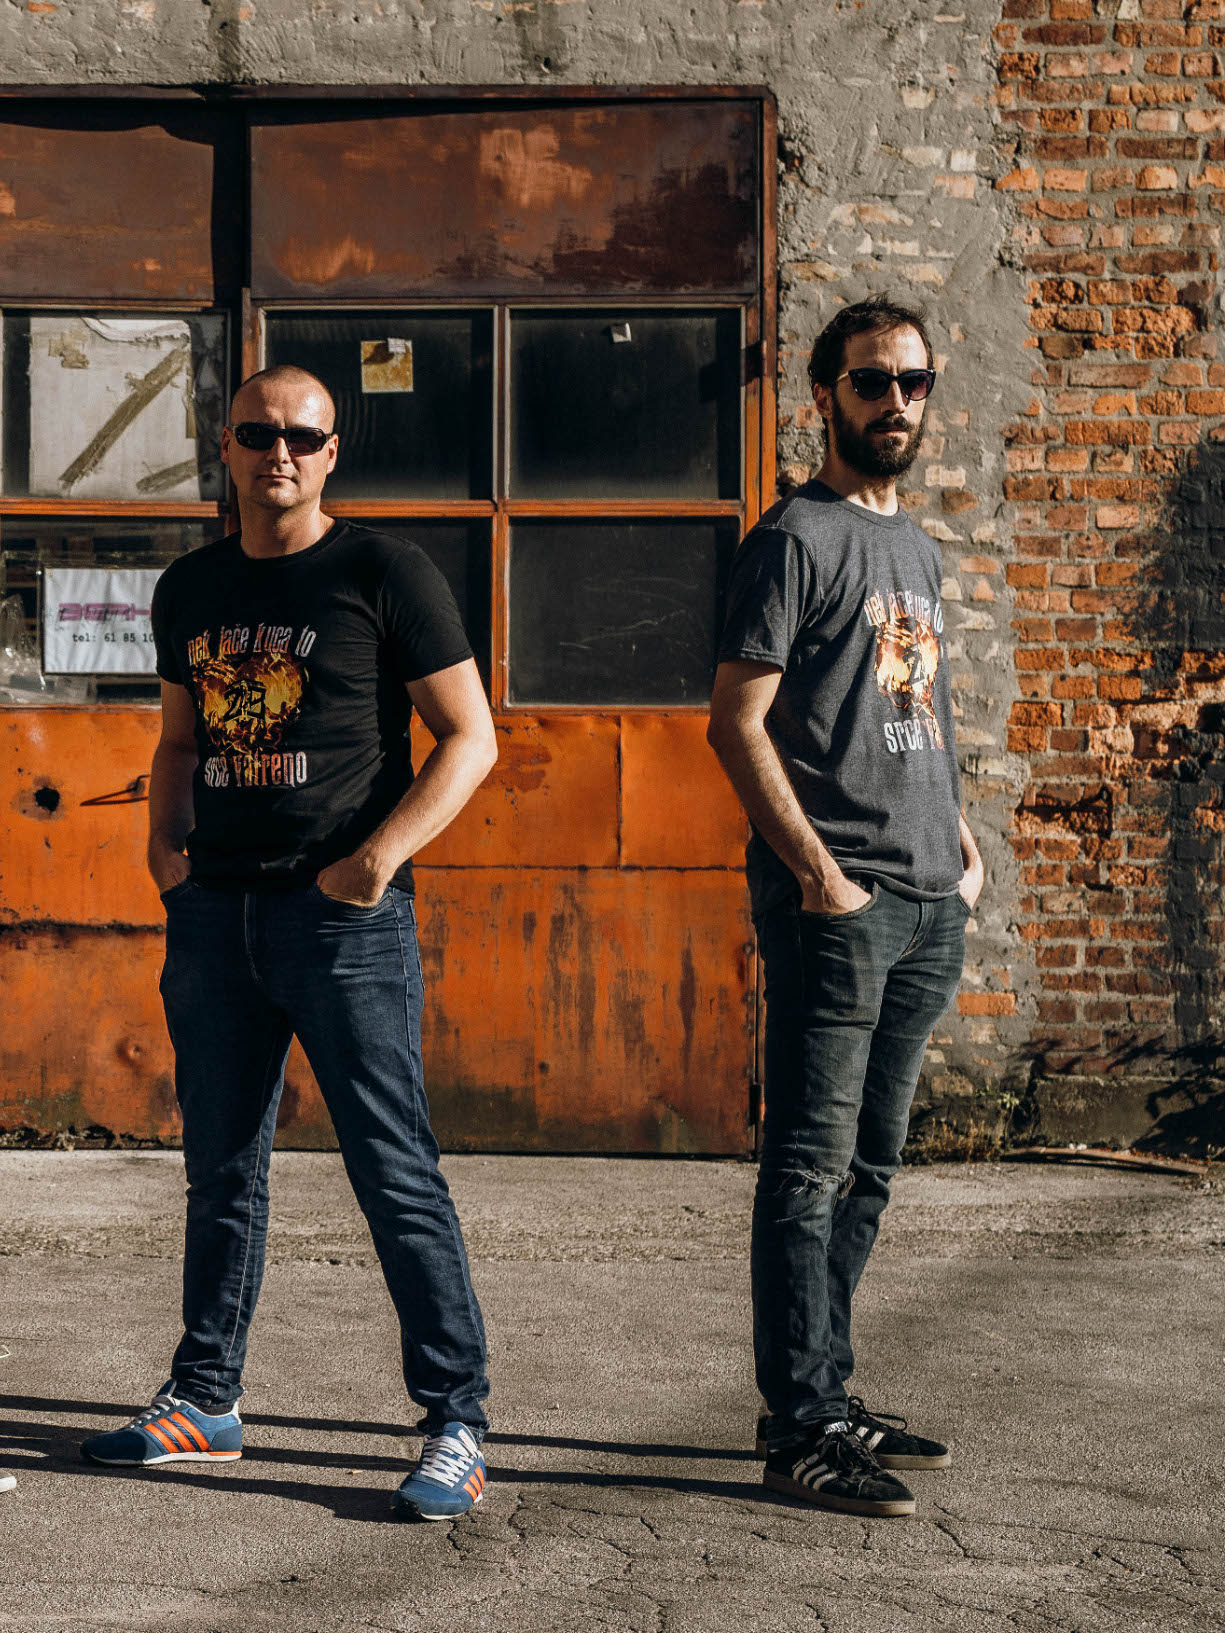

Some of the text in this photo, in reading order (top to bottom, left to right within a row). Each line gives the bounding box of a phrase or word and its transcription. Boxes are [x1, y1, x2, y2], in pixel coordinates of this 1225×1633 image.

[72, 632, 96, 643] tel:
[104, 632, 116, 642] 61
[123, 632, 136, 642] 85
[188, 629, 211, 666] nek
[253, 622, 293, 653] kuca
[295, 624, 316, 657] to
[883, 719, 923, 753] srce
[233, 748, 307, 788] vatreno
